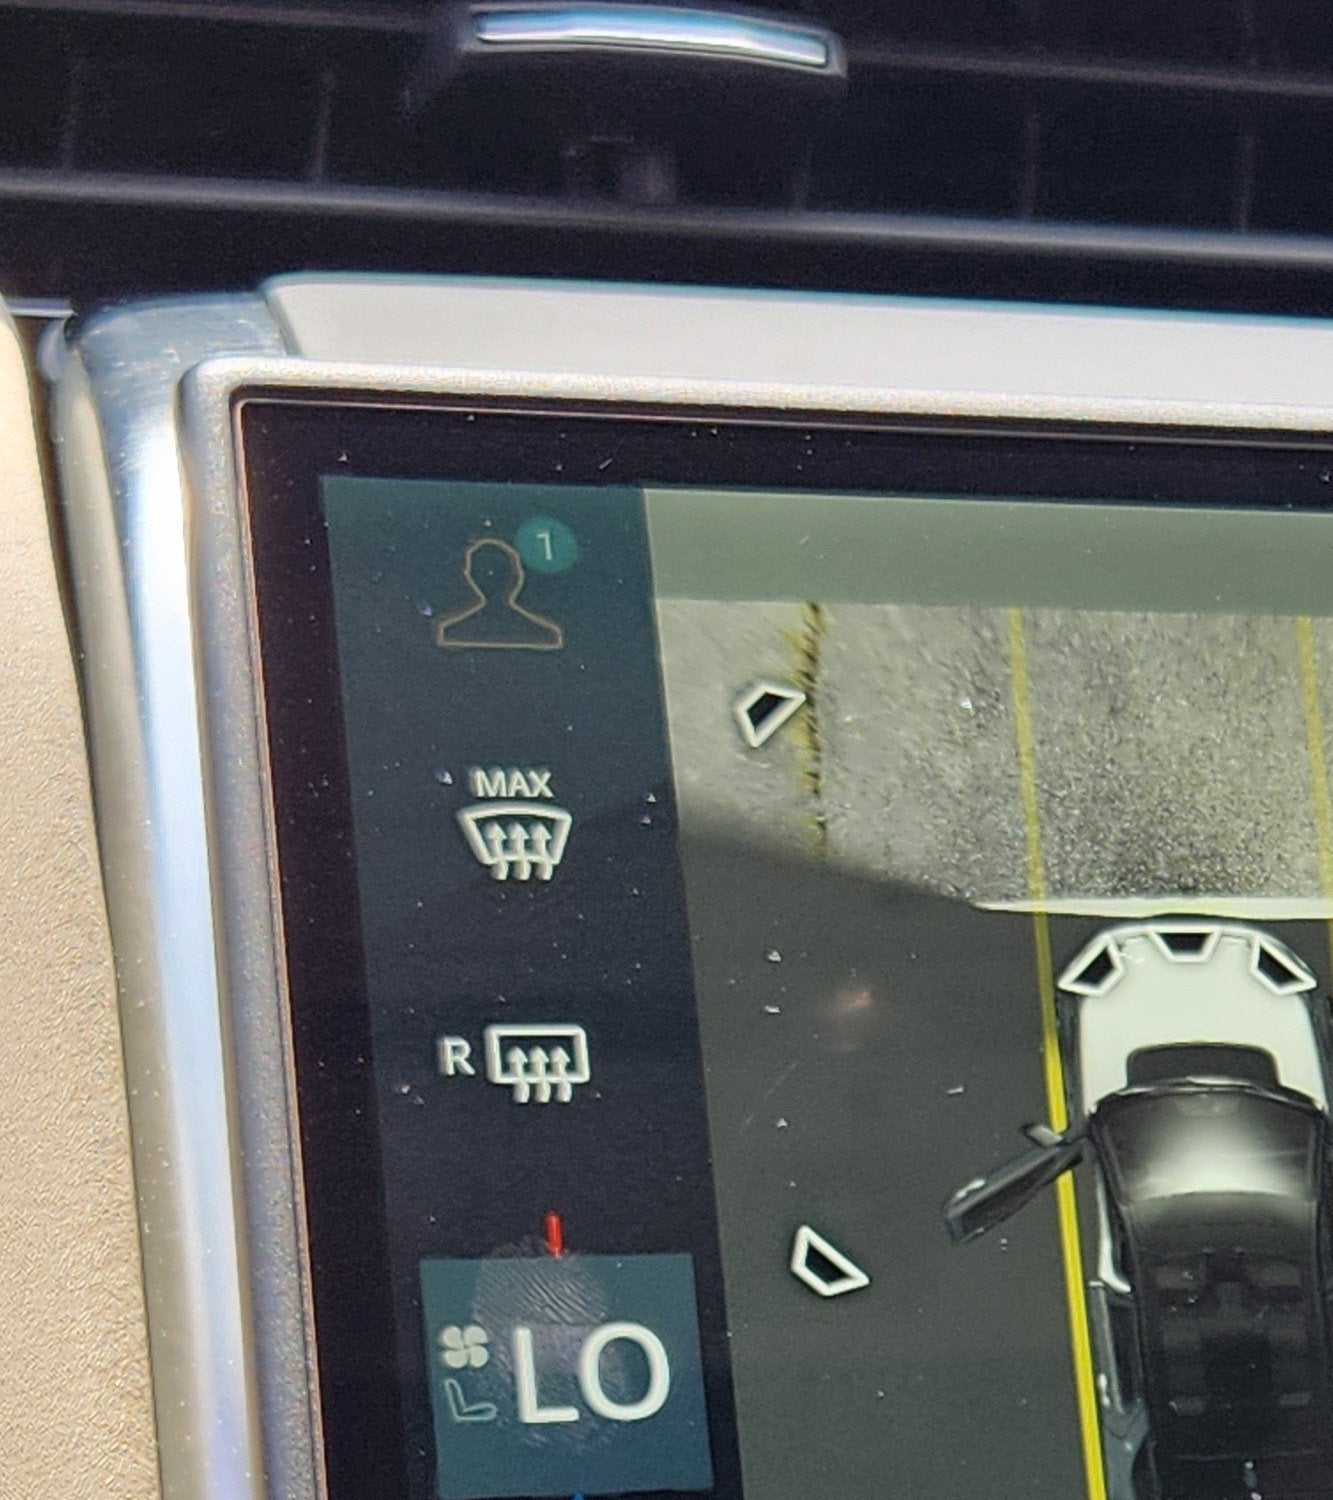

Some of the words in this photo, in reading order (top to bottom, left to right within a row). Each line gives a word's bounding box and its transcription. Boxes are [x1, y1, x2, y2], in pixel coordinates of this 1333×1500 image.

[469, 767, 555, 799] MAX
[439, 1036, 475, 1076] R
[512, 1322, 672, 1426] LO
